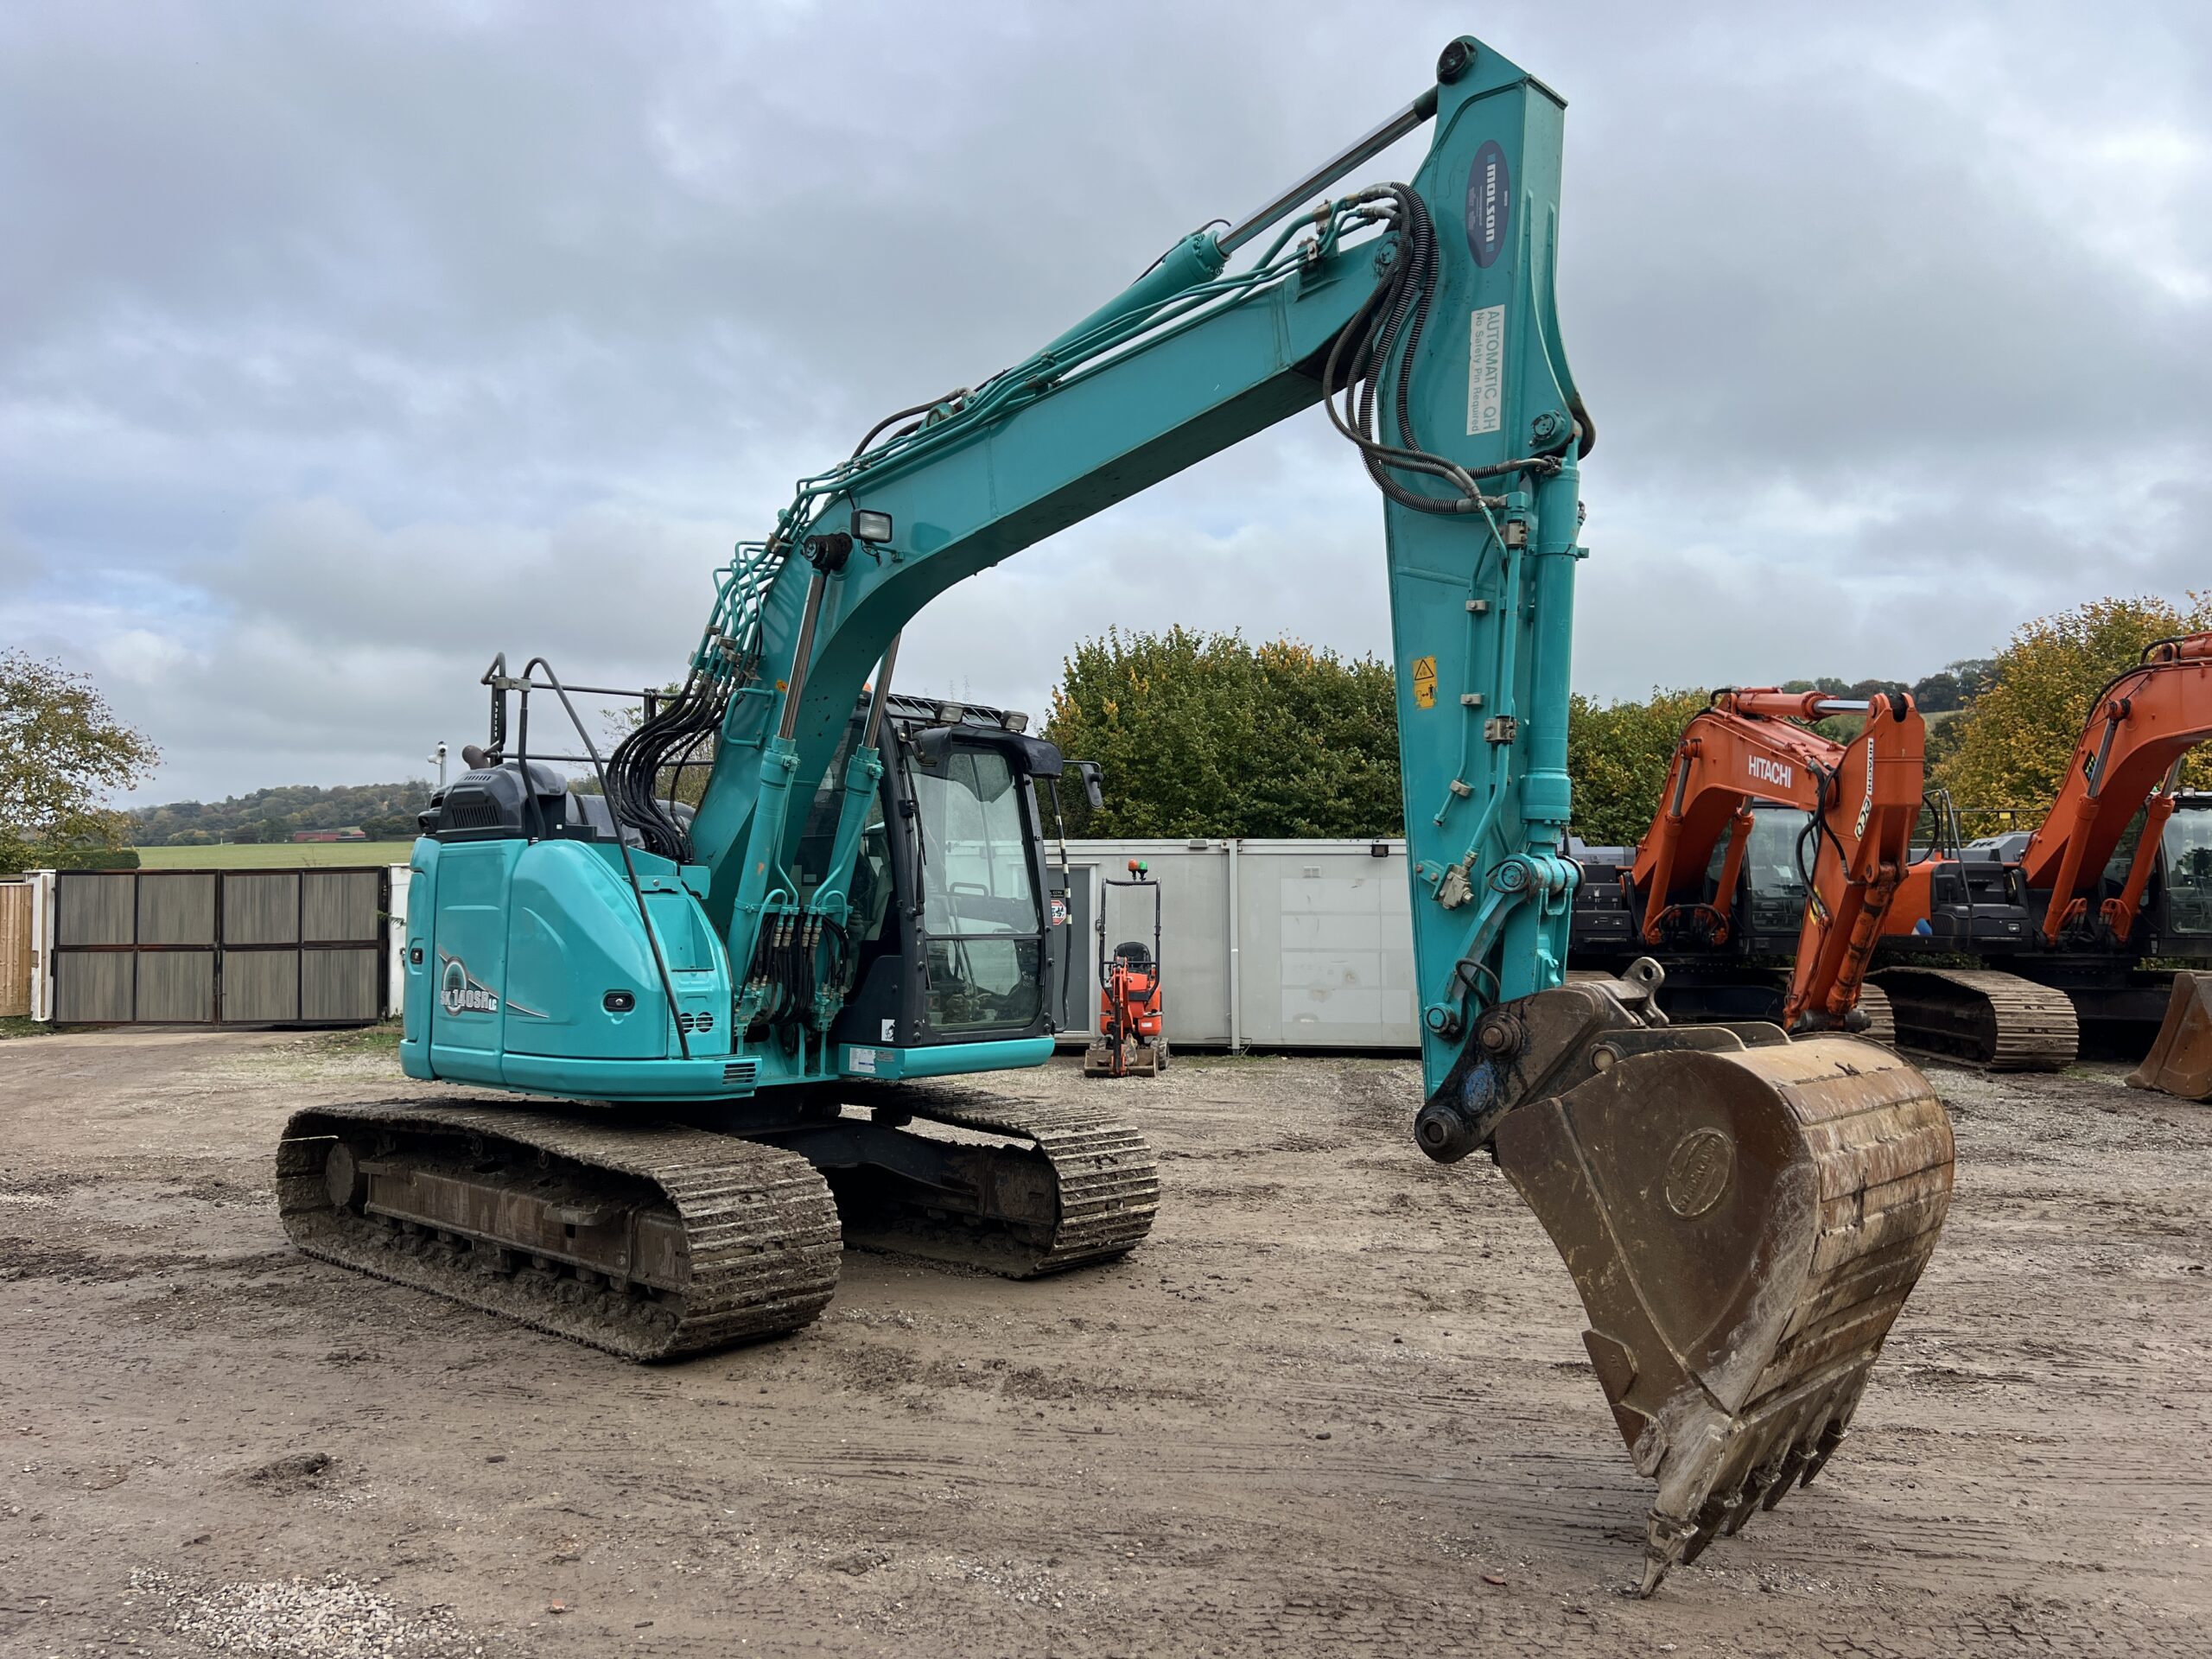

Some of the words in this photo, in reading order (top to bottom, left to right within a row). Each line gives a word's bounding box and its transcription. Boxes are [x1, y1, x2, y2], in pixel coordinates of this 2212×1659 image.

[1475, 312, 1484, 327] No
[1473, 330, 1484, 364] Safety
[1484, 310, 1500, 399] AUTOMATIC
[1473, 368, 1482, 383] Pin
[1471, 387, 1481, 432] Required
[1483, 406, 1497, 429] QH
[1749, 754, 1792, 788] HITACHI
